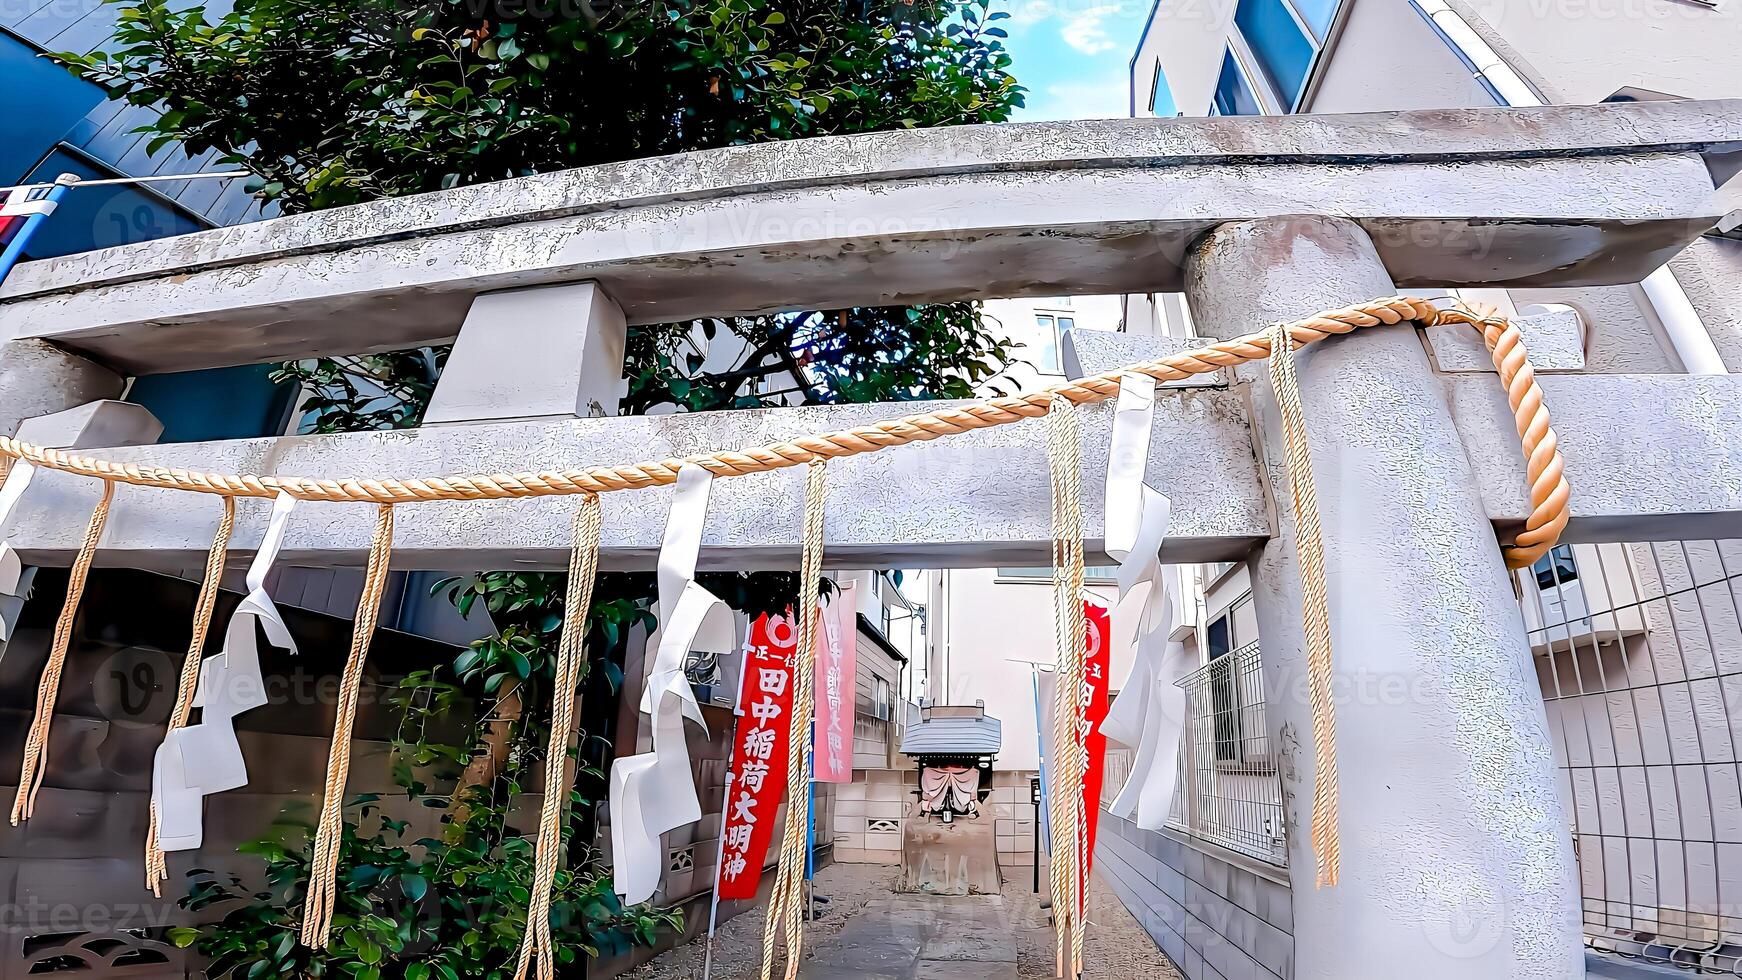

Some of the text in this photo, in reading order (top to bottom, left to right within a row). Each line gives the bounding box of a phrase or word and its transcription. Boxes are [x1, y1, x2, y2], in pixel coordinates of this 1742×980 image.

[722, 668, 789, 884] 田中稲荷大明神
